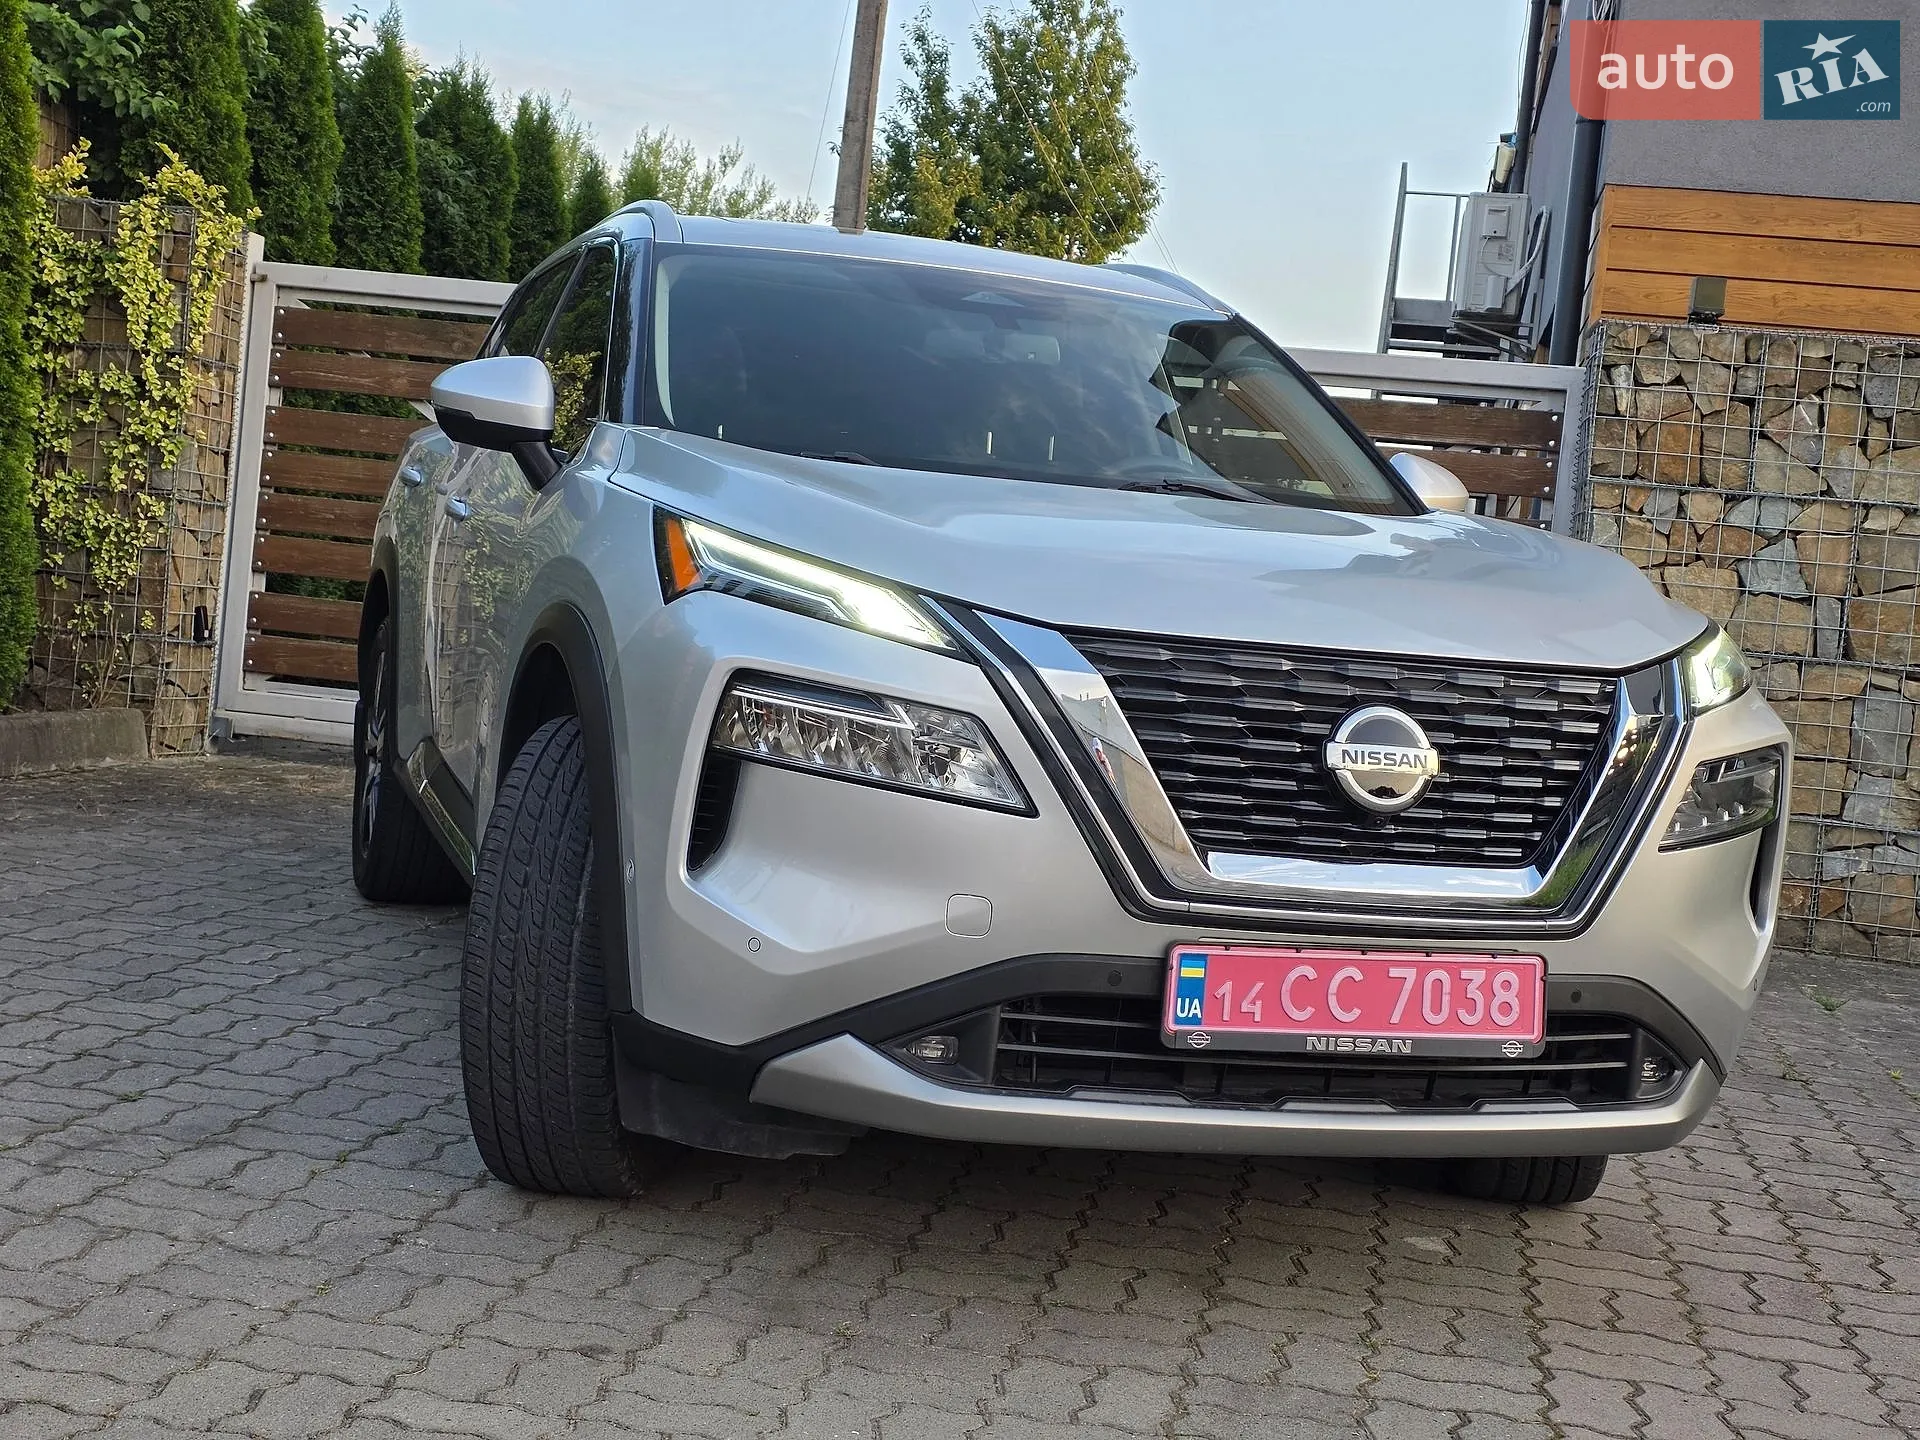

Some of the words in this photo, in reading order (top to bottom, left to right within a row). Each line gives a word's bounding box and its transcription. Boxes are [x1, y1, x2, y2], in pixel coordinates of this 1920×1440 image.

[1341, 748, 1428, 769] NISSAN
[1213, 979, 1265, 1023] 14
[1280, 964, 1364, 1024] CC
[1388, 966, 1520, 1028] 7038
[1176, 997, 1202, 1019] UA
[1306, 1036, 1413, 1054] NISSAN
